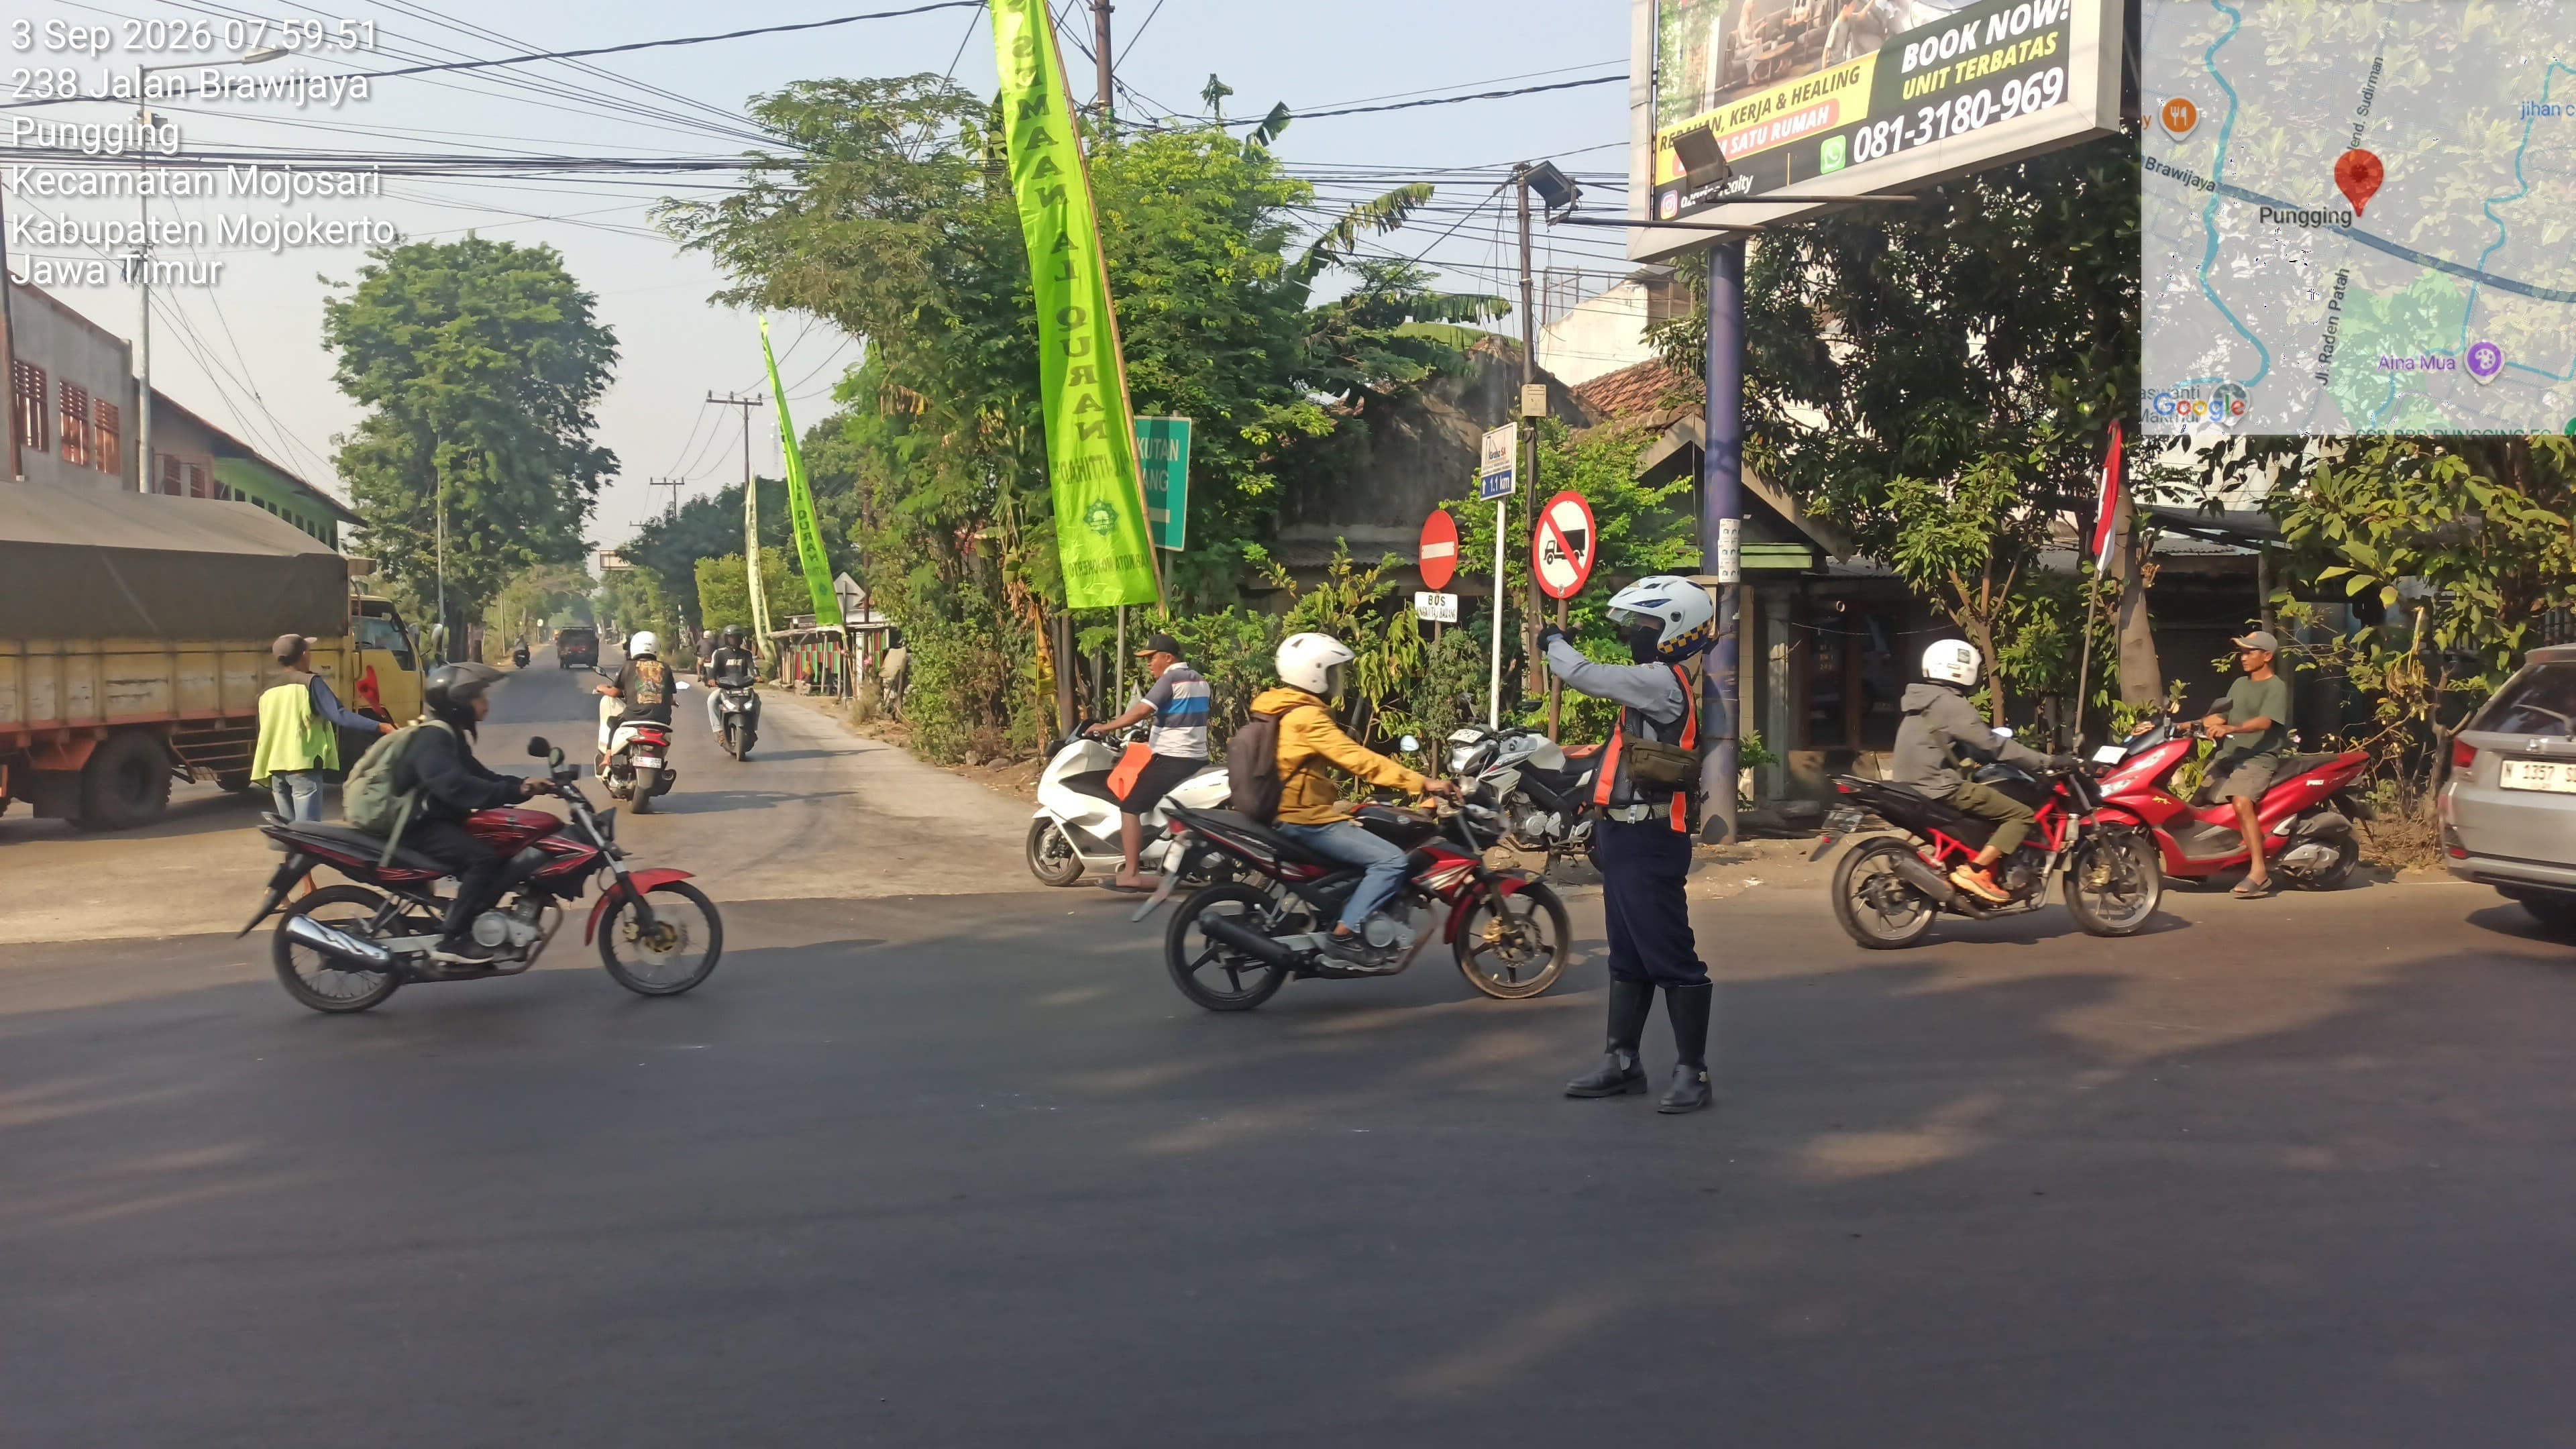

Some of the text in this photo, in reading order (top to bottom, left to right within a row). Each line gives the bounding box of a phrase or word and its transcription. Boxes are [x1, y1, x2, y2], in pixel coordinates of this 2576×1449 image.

[1900, 0, 2071, 74] BOOK NOW!
[1902, 31, 2059, 101] UNIT TERBATAS
[1729, 97, 1772, 123] KERJA
[1776, 93, 1787, 110] &
[1791, 65, 1861, 106] HEALING
[1853, 66, 2065, 164] 081-3180-969
[1729, 105, 1830, 154] SATU RUMAH
[1499, 474, 1510, 491] km
[1428, 594, 1446, 606] BUS
[2565, 767, 2576, 782] S
